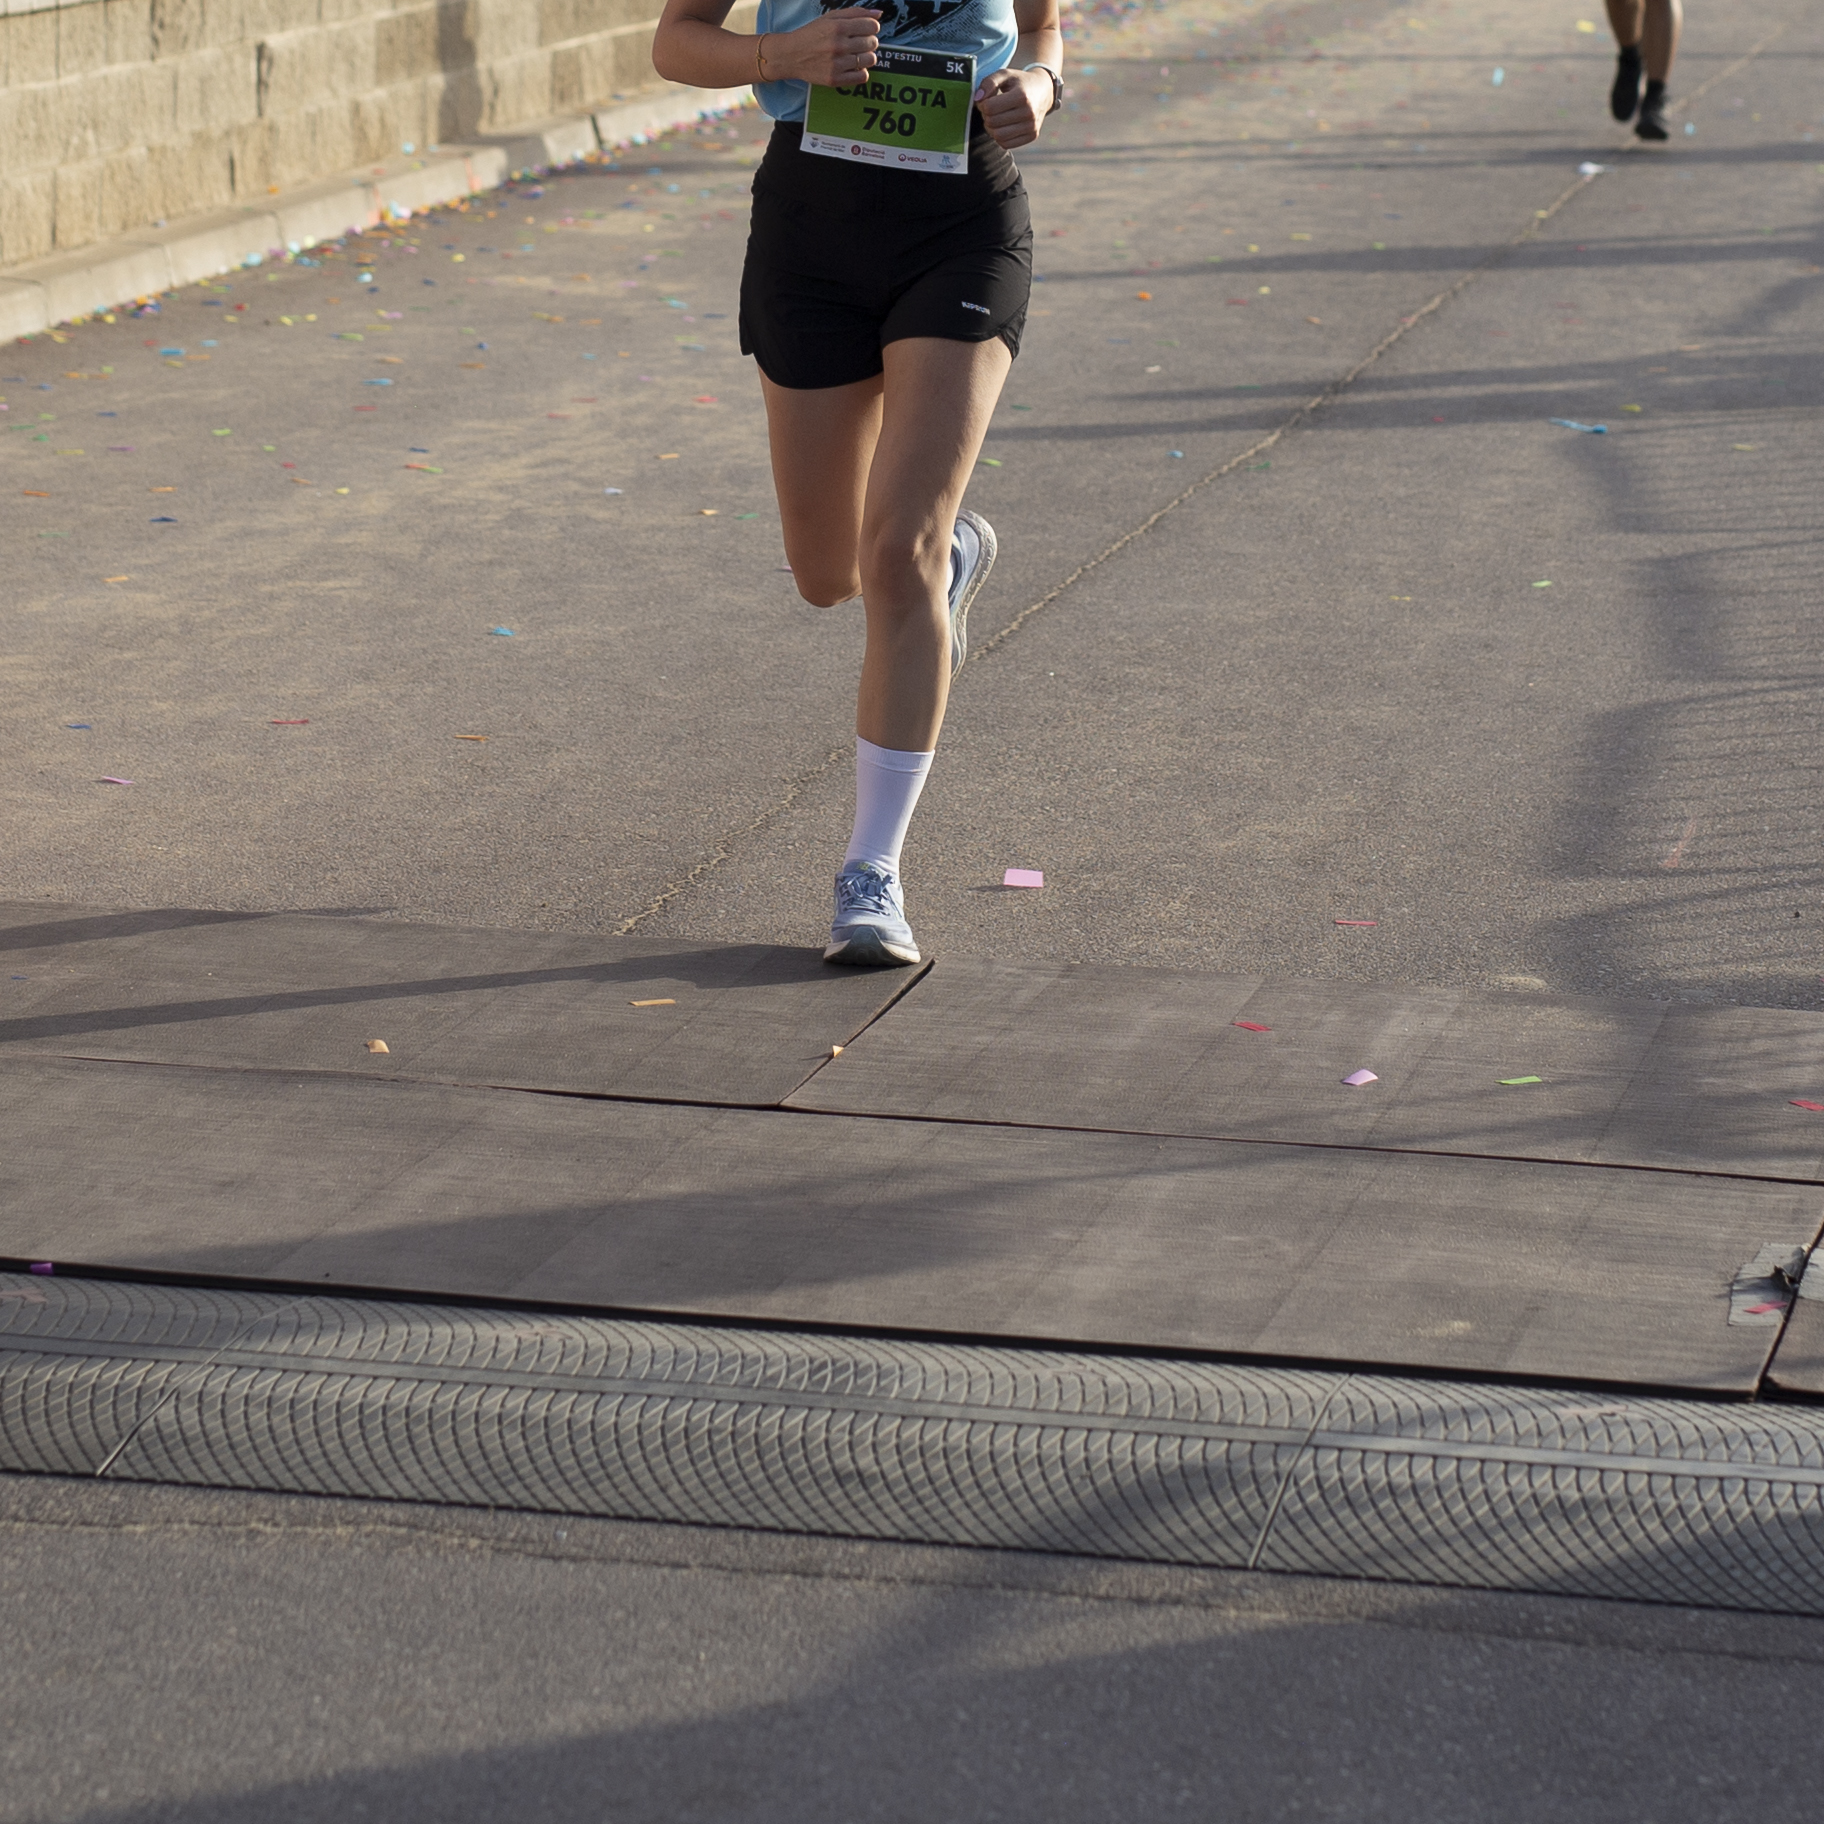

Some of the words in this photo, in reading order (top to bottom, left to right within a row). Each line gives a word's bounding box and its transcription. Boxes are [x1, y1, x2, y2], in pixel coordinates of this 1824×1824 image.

[885, 51, 922, 63] D'ESTIU
[946, 61, 965, 75] 5K
[862, 107, 917, 138] 760
